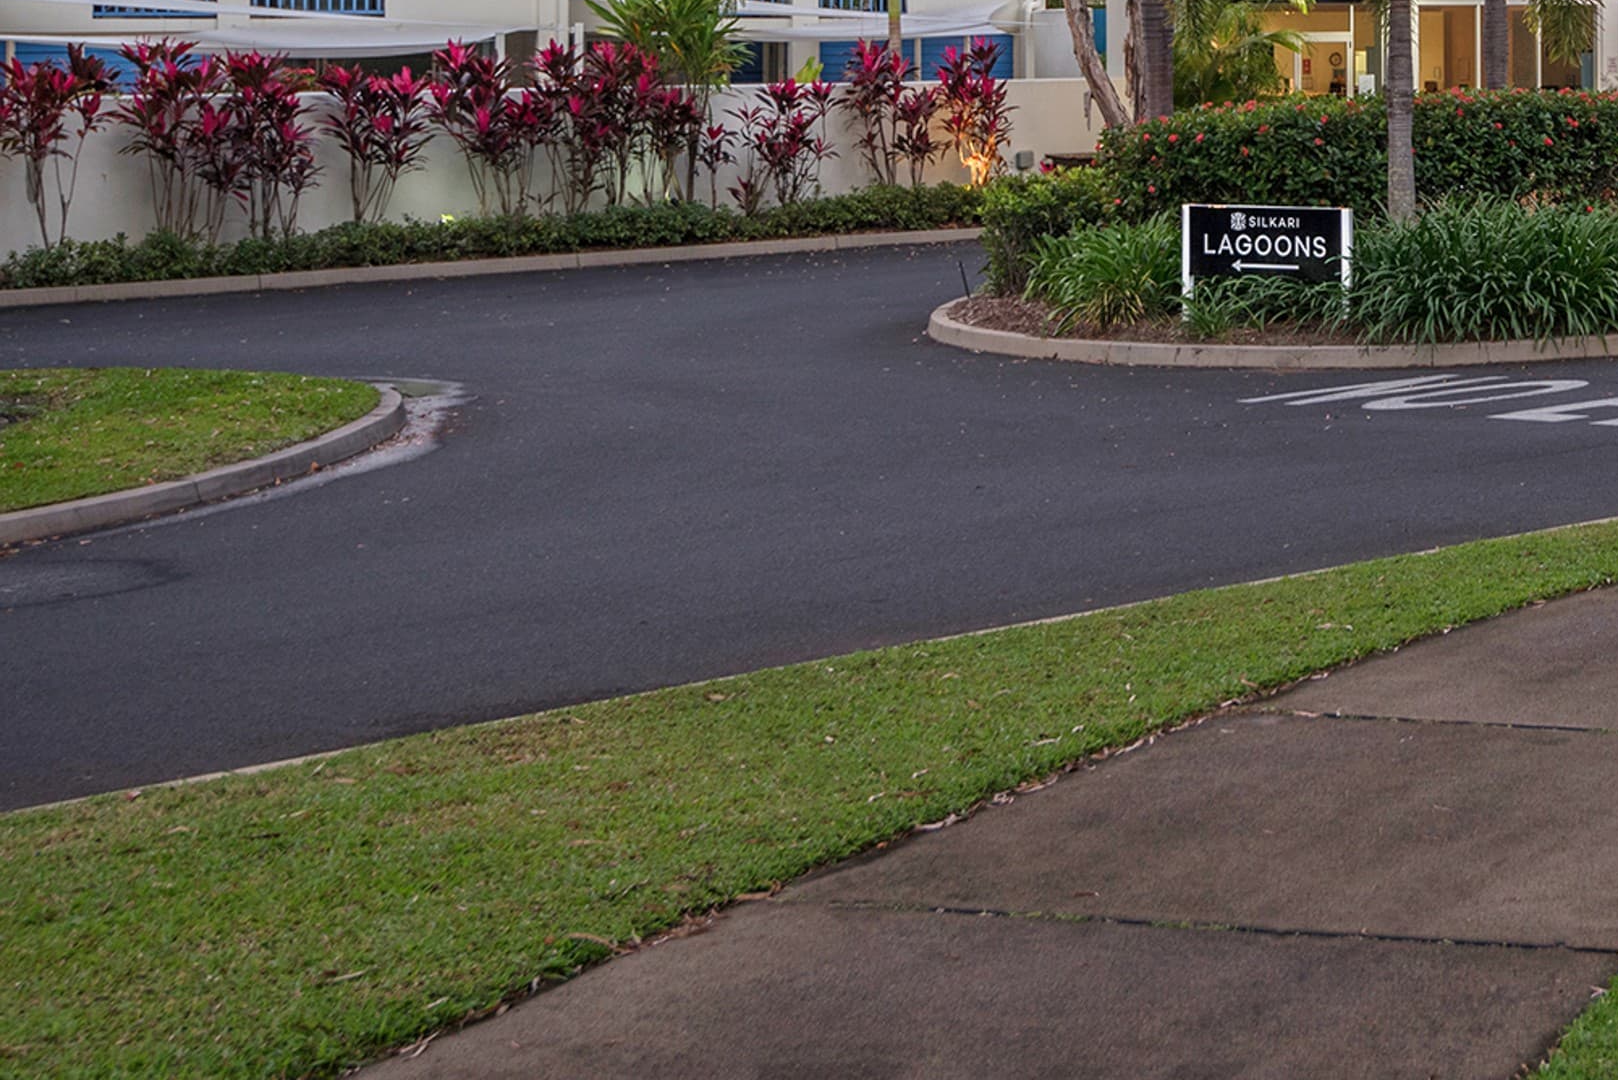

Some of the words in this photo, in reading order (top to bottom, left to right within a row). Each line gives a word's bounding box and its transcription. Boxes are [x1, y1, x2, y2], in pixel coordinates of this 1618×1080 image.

[1249, 217, 1300, 228] SILKARI
[1204, 234, 1327, 258] LAGOONS
[1237, 374, 1589, 410] NO
